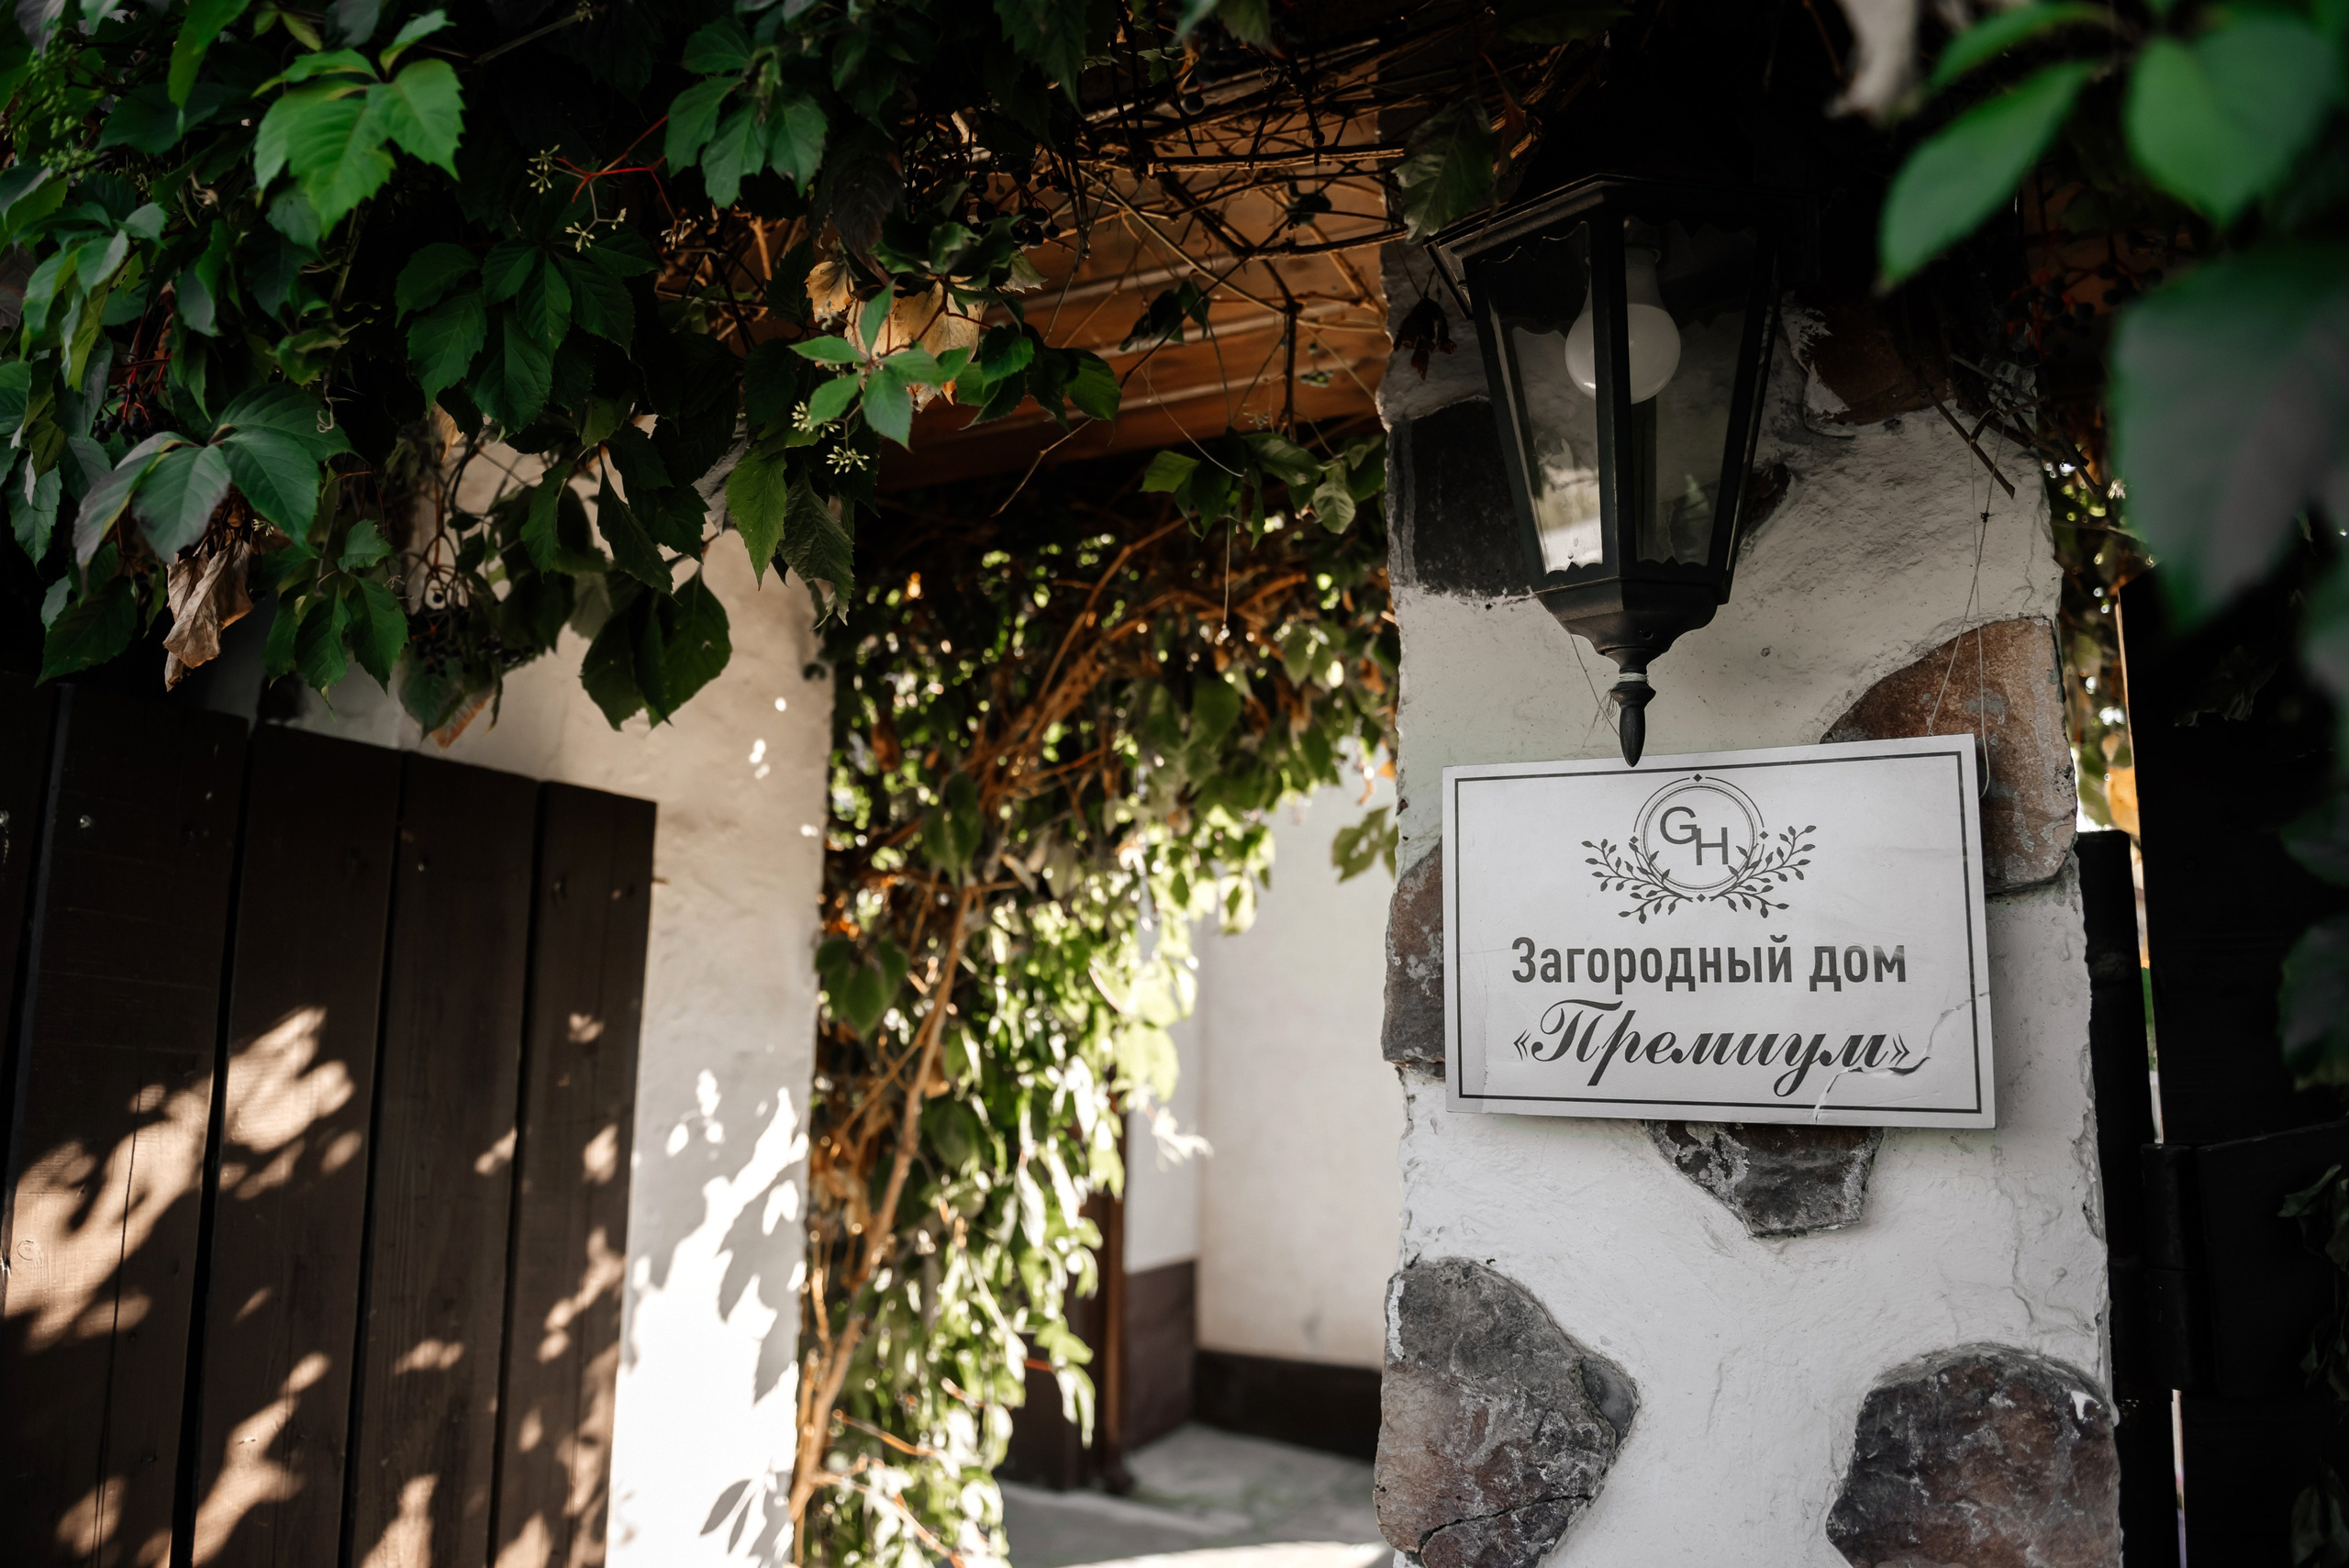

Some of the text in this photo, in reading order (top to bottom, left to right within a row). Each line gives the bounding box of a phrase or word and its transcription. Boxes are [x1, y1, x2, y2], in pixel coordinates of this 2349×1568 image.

[1511, 934, 1907, 995] Загородный дом
[1512, 998, 1910, 1097] «Премиум»
